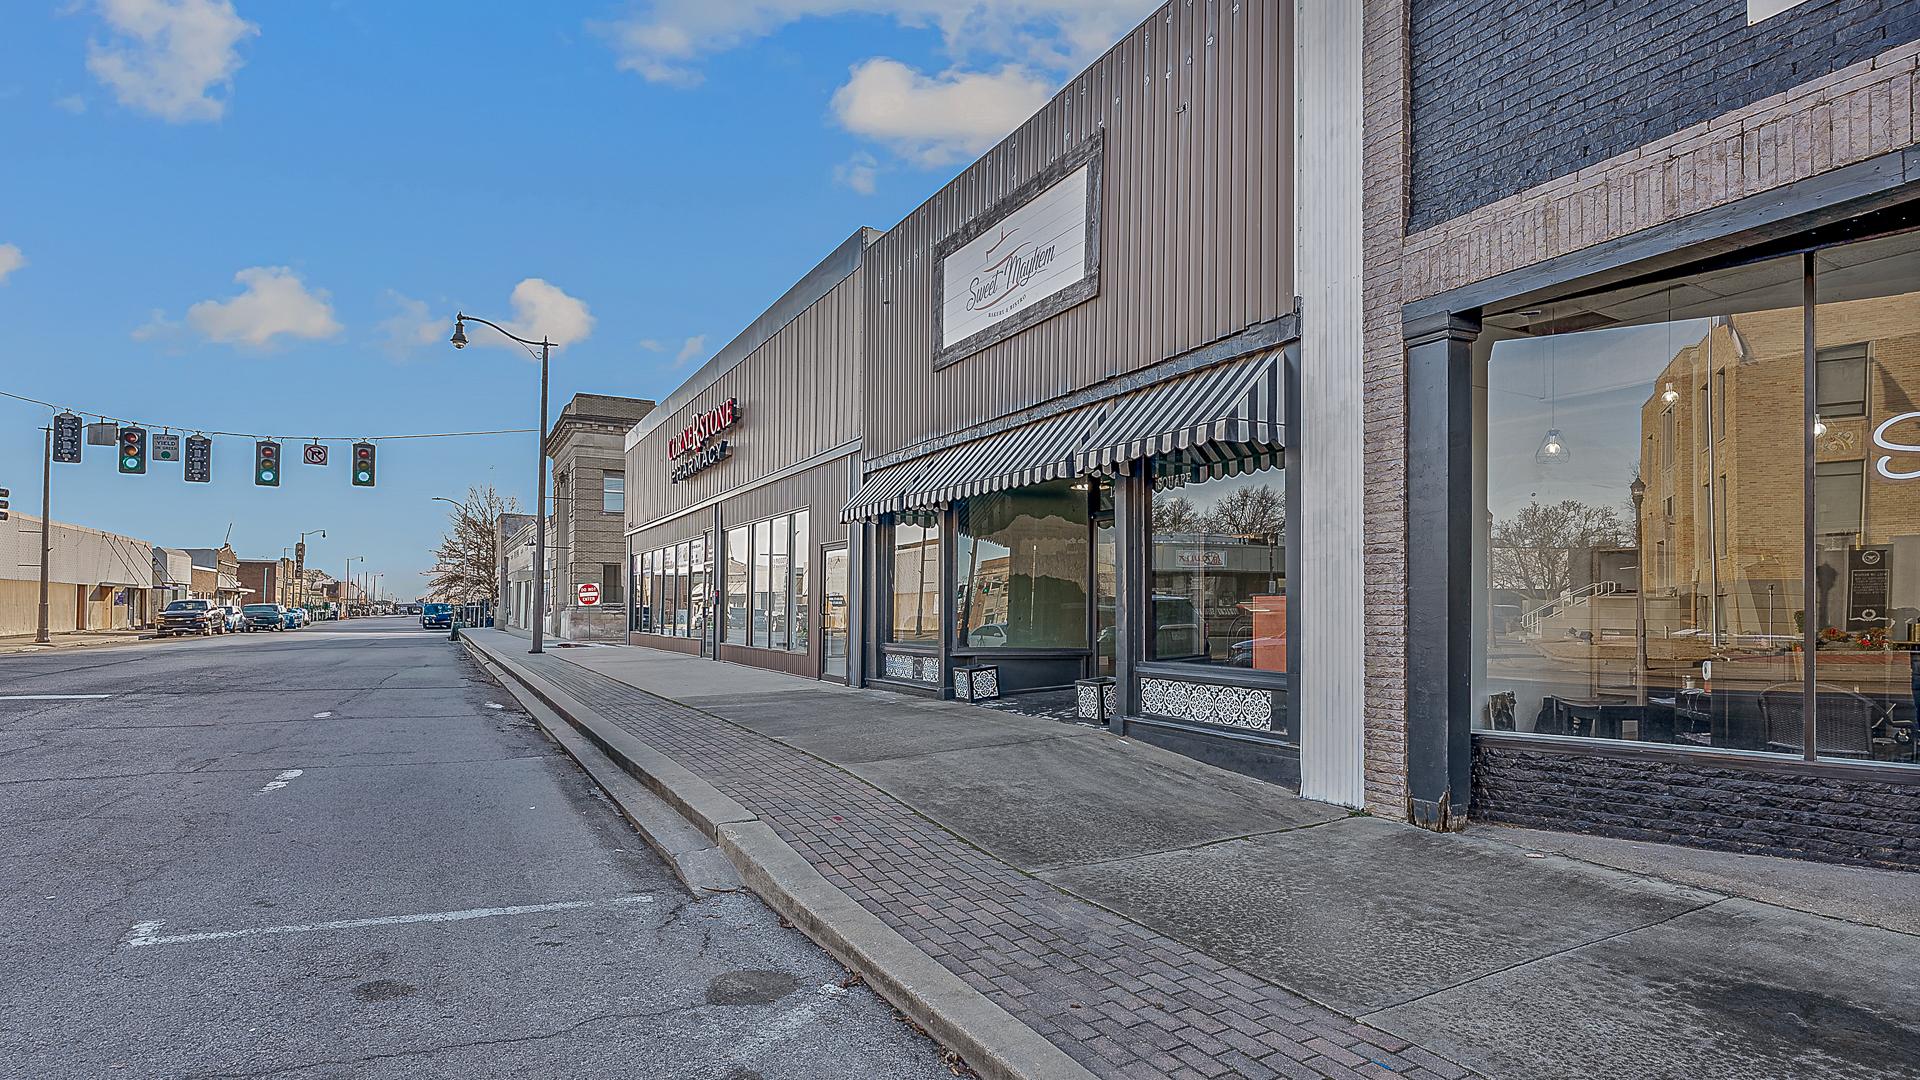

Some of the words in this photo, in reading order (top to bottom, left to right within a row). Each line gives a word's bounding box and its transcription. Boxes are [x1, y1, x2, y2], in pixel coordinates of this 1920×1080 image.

[966, 270, 1003, 311] Sweet
[1004, 245, 1055, 289] Mayhem
[1009, 294, 1027, 311] BISTRO
[668, 398, 733, 461] CORNERSTONE
[671, 442, 723, 481] PHARMACY
[1157, 471, 1192, 491] SQUARE
